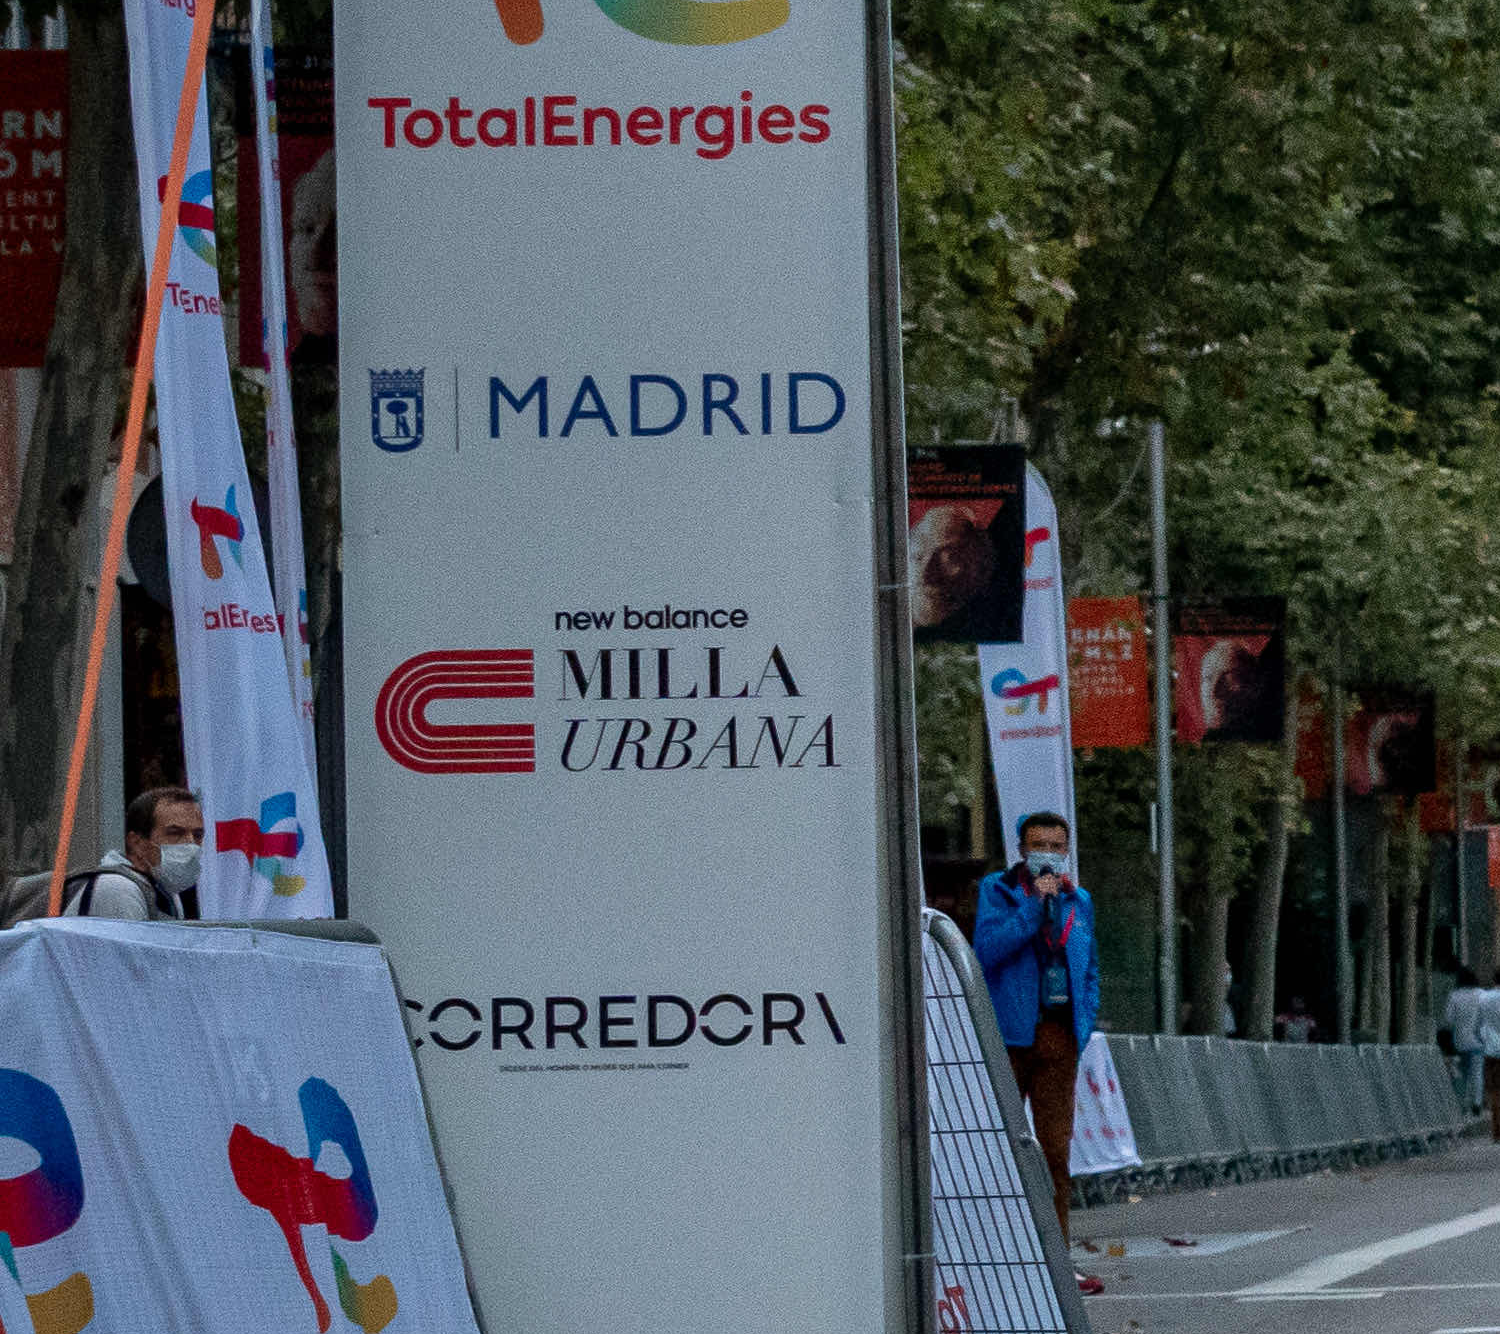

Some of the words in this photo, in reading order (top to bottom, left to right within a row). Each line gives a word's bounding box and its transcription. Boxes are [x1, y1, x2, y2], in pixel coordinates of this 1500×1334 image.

[367, 90, 831, 161] TotalEnergies
[488, 371, 848, 439] MADRID
[554, 609, 616, 632] new
[622, 603, 749, 631] balance
[558, 643, 802, 702] MILLA
[560, 713, 841, 773] URBANA
